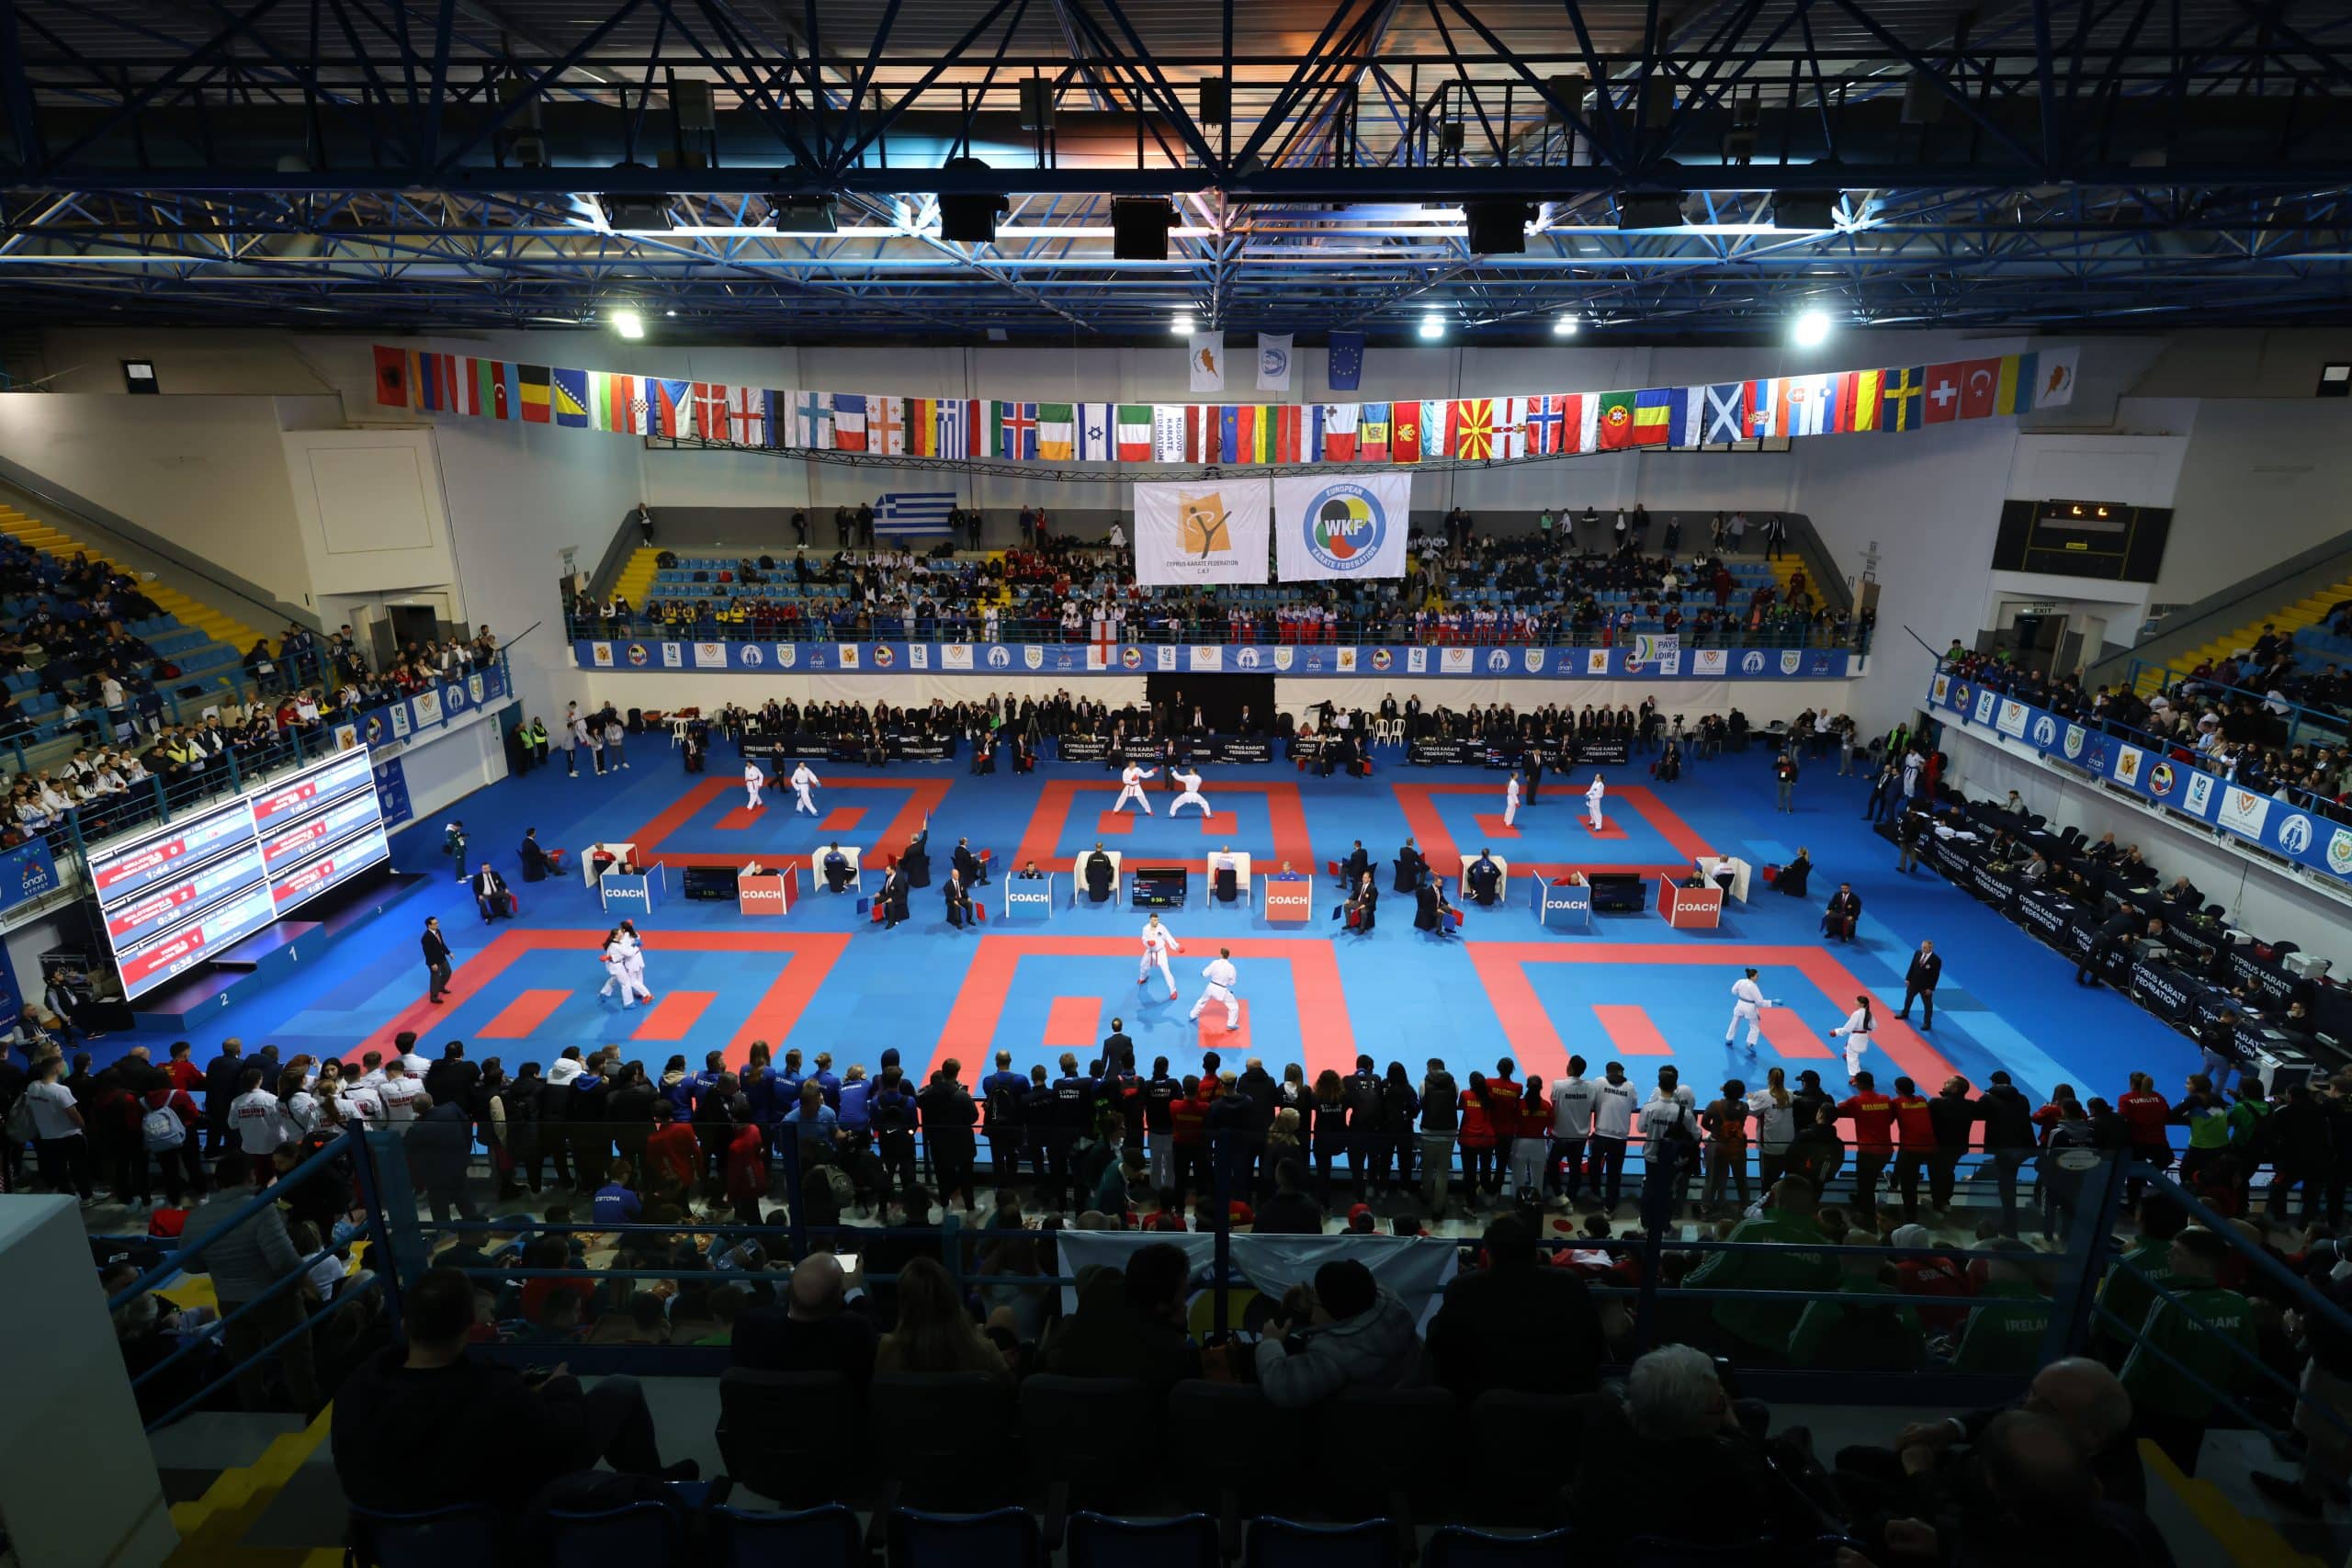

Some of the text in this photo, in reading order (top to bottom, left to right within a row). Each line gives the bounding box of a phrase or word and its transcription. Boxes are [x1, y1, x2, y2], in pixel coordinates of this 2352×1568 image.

[1326, 485, 1363, 496] EUROPEAN
[1324, 518, 1363, 536] WKF
[1312, 546, 1378, 570] KARATE FEDERATION
[1657, 640, 1678, 649] PAYS
[1655, 651, 1677, 660] LOIRE
[169, 845, 178, 855] 0
[145, 863, 170, 880] 1:44
[1973, 865, 2014, 895] CYPRUS KARATE
[1974, 874, 2007, 900] FEDERATION
[180, 890, 188, 901] 2
[605, 888, 644, 898] COACH
[741, 890, 782, 899] COACH
[1010, 893, 1049, 903] COACH
[1268, 896, 1308, 906] COACH
[1546, 900, 1588, 910] COACH
[1677, 903, 1718, 913] COACH
[156, 908, 181, 926] 0:38
[2018, 894, 2064, 927] CYPRUS KARATE
[2021, 904, 2056, 932] FEDERATION
[2072, 925, 2093, 944] CYPRU
[288, 949, 298, 961] 1
[2229, 952, 2293, 994] CYPRUS KARATE
[2131, 962, 2188, 1004] CYPRUS KARATE
[2233, 964, 2282, 998] FEDTION
[2134, 974, 2177, 1008] FEDERATION
[220, 993, 229, 1007] 2
[775, 1076, 797, 1087] ESTONIA
[2144, 1268, 2173, 1280] IREL
[2005, 1316, 2048, 1332] IRELA
